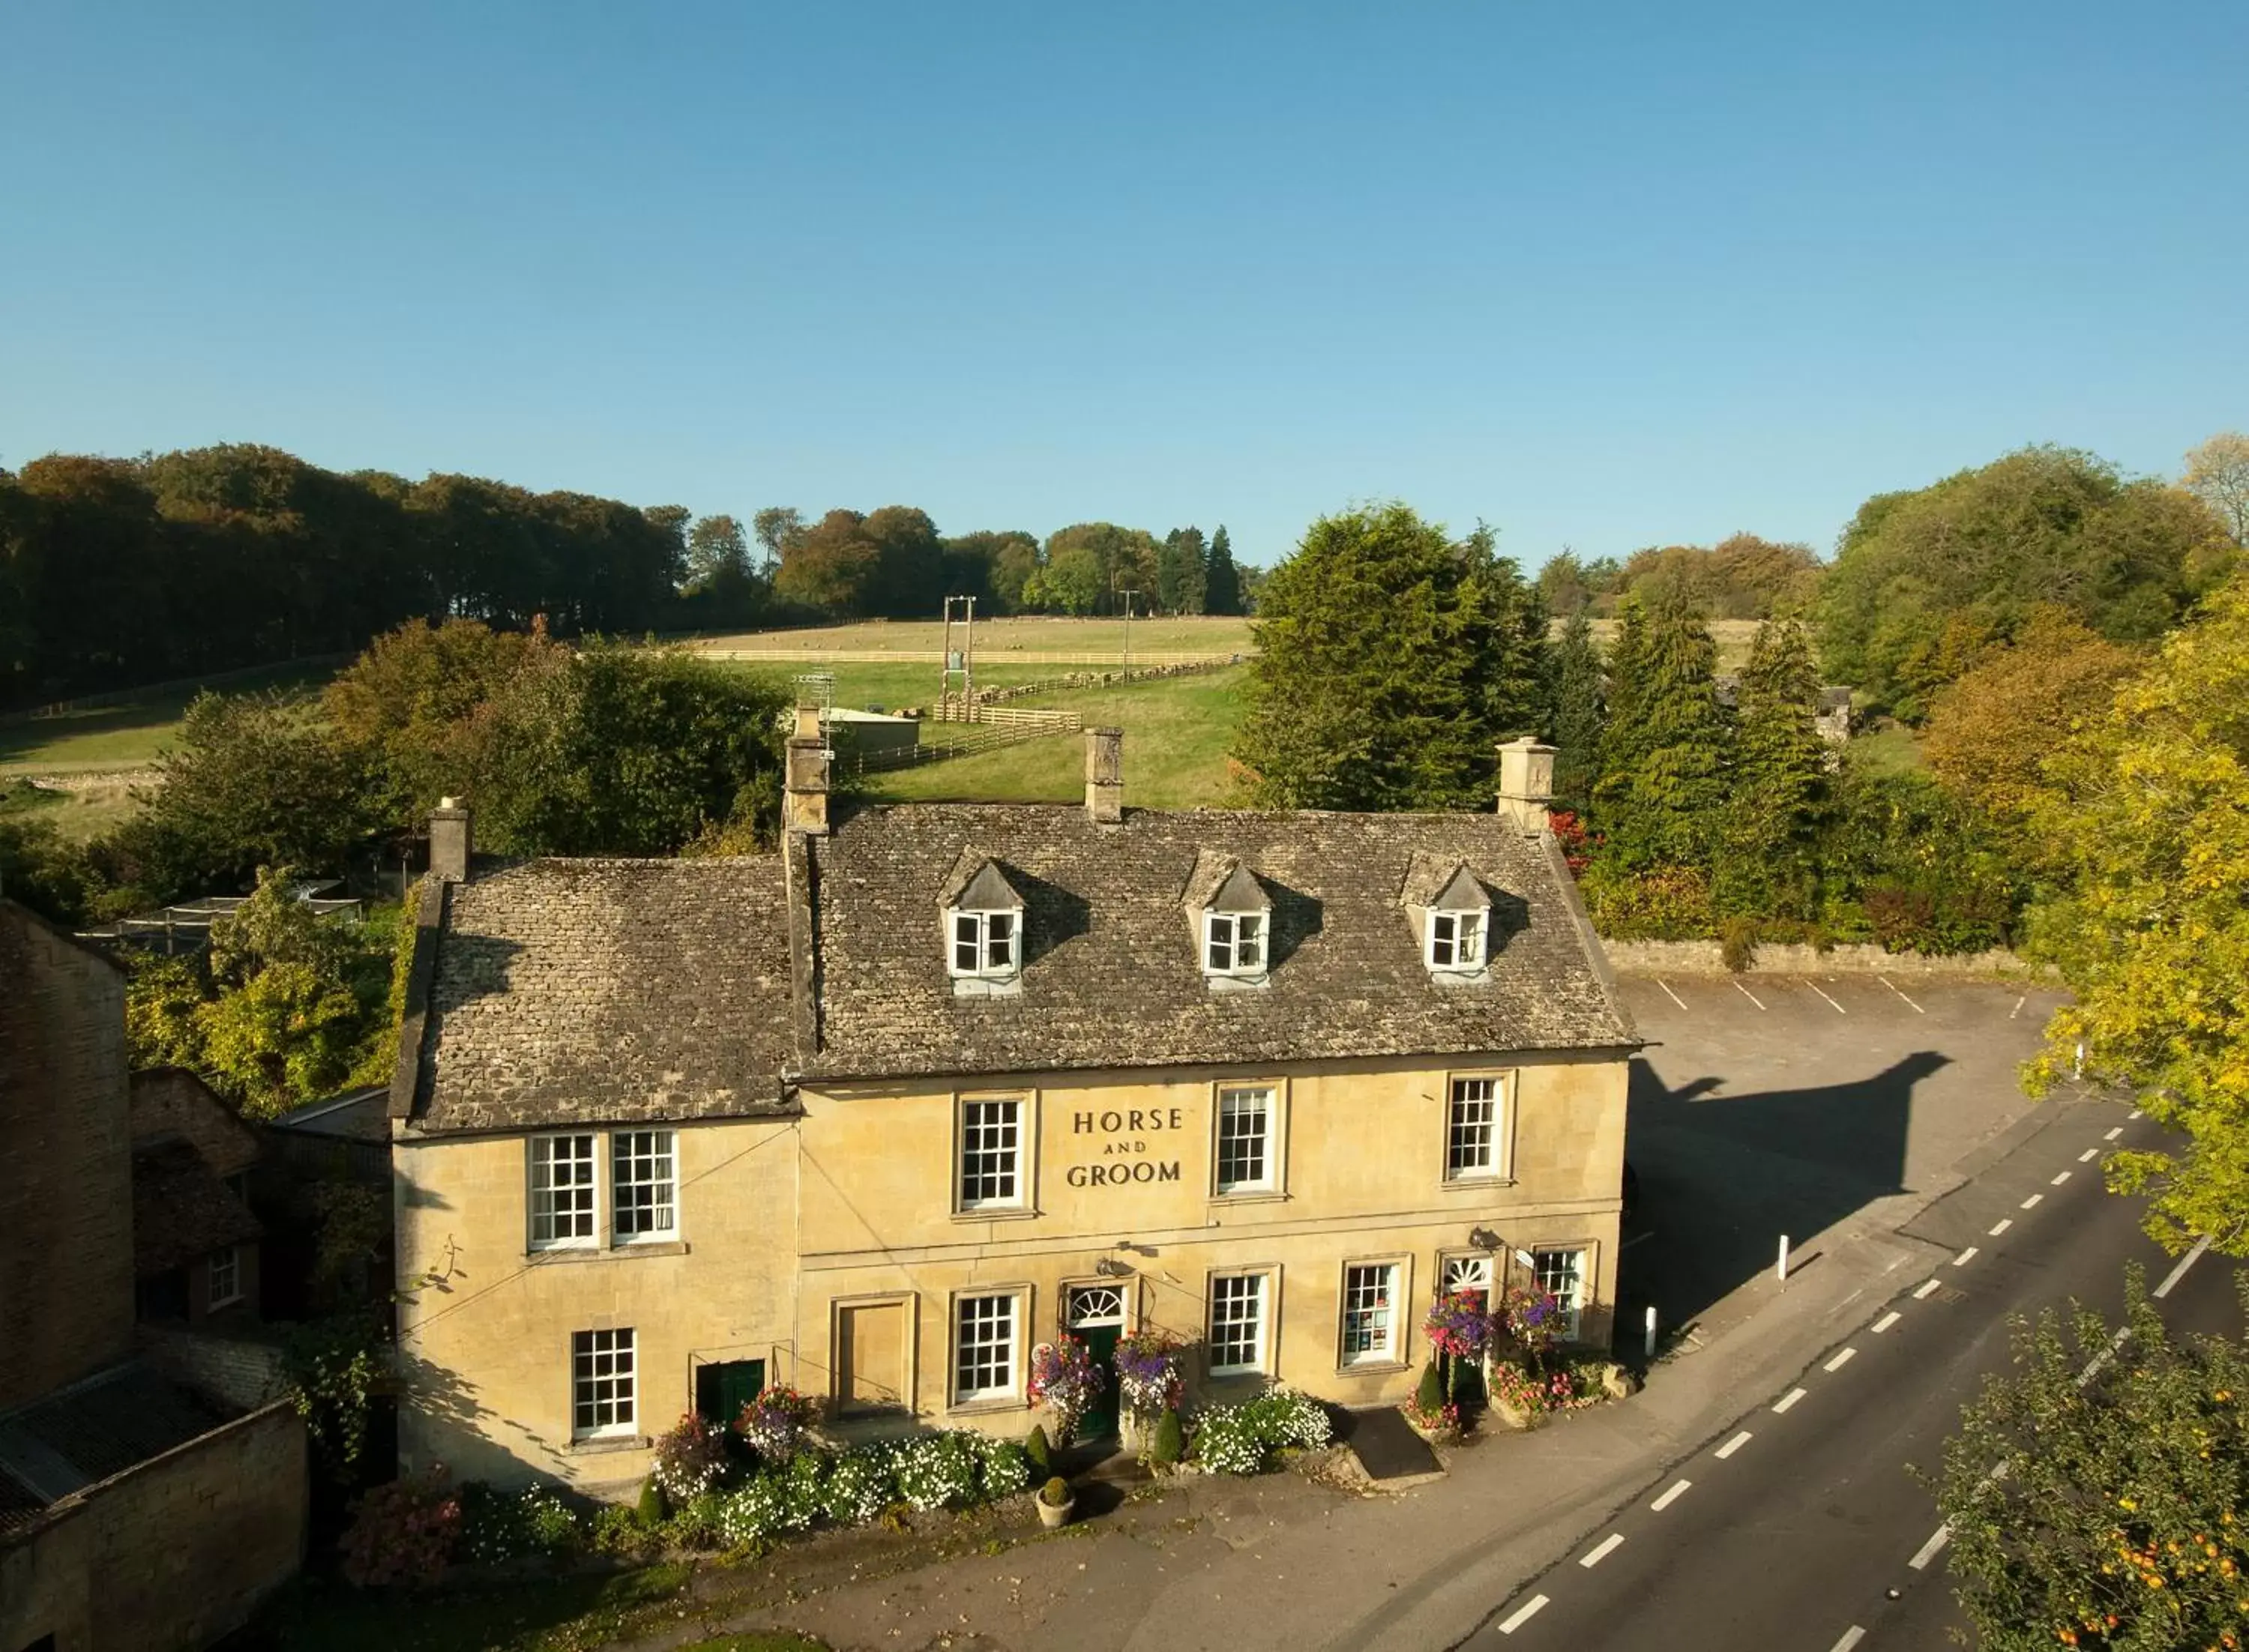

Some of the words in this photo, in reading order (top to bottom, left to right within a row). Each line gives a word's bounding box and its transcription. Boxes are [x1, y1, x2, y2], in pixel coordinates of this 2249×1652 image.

[1074, 1109, 1182, 1133] HORSE
[1104, 1141, 1146, 1154] AND
[1067, 1161, 1180, 1187] GROOM
